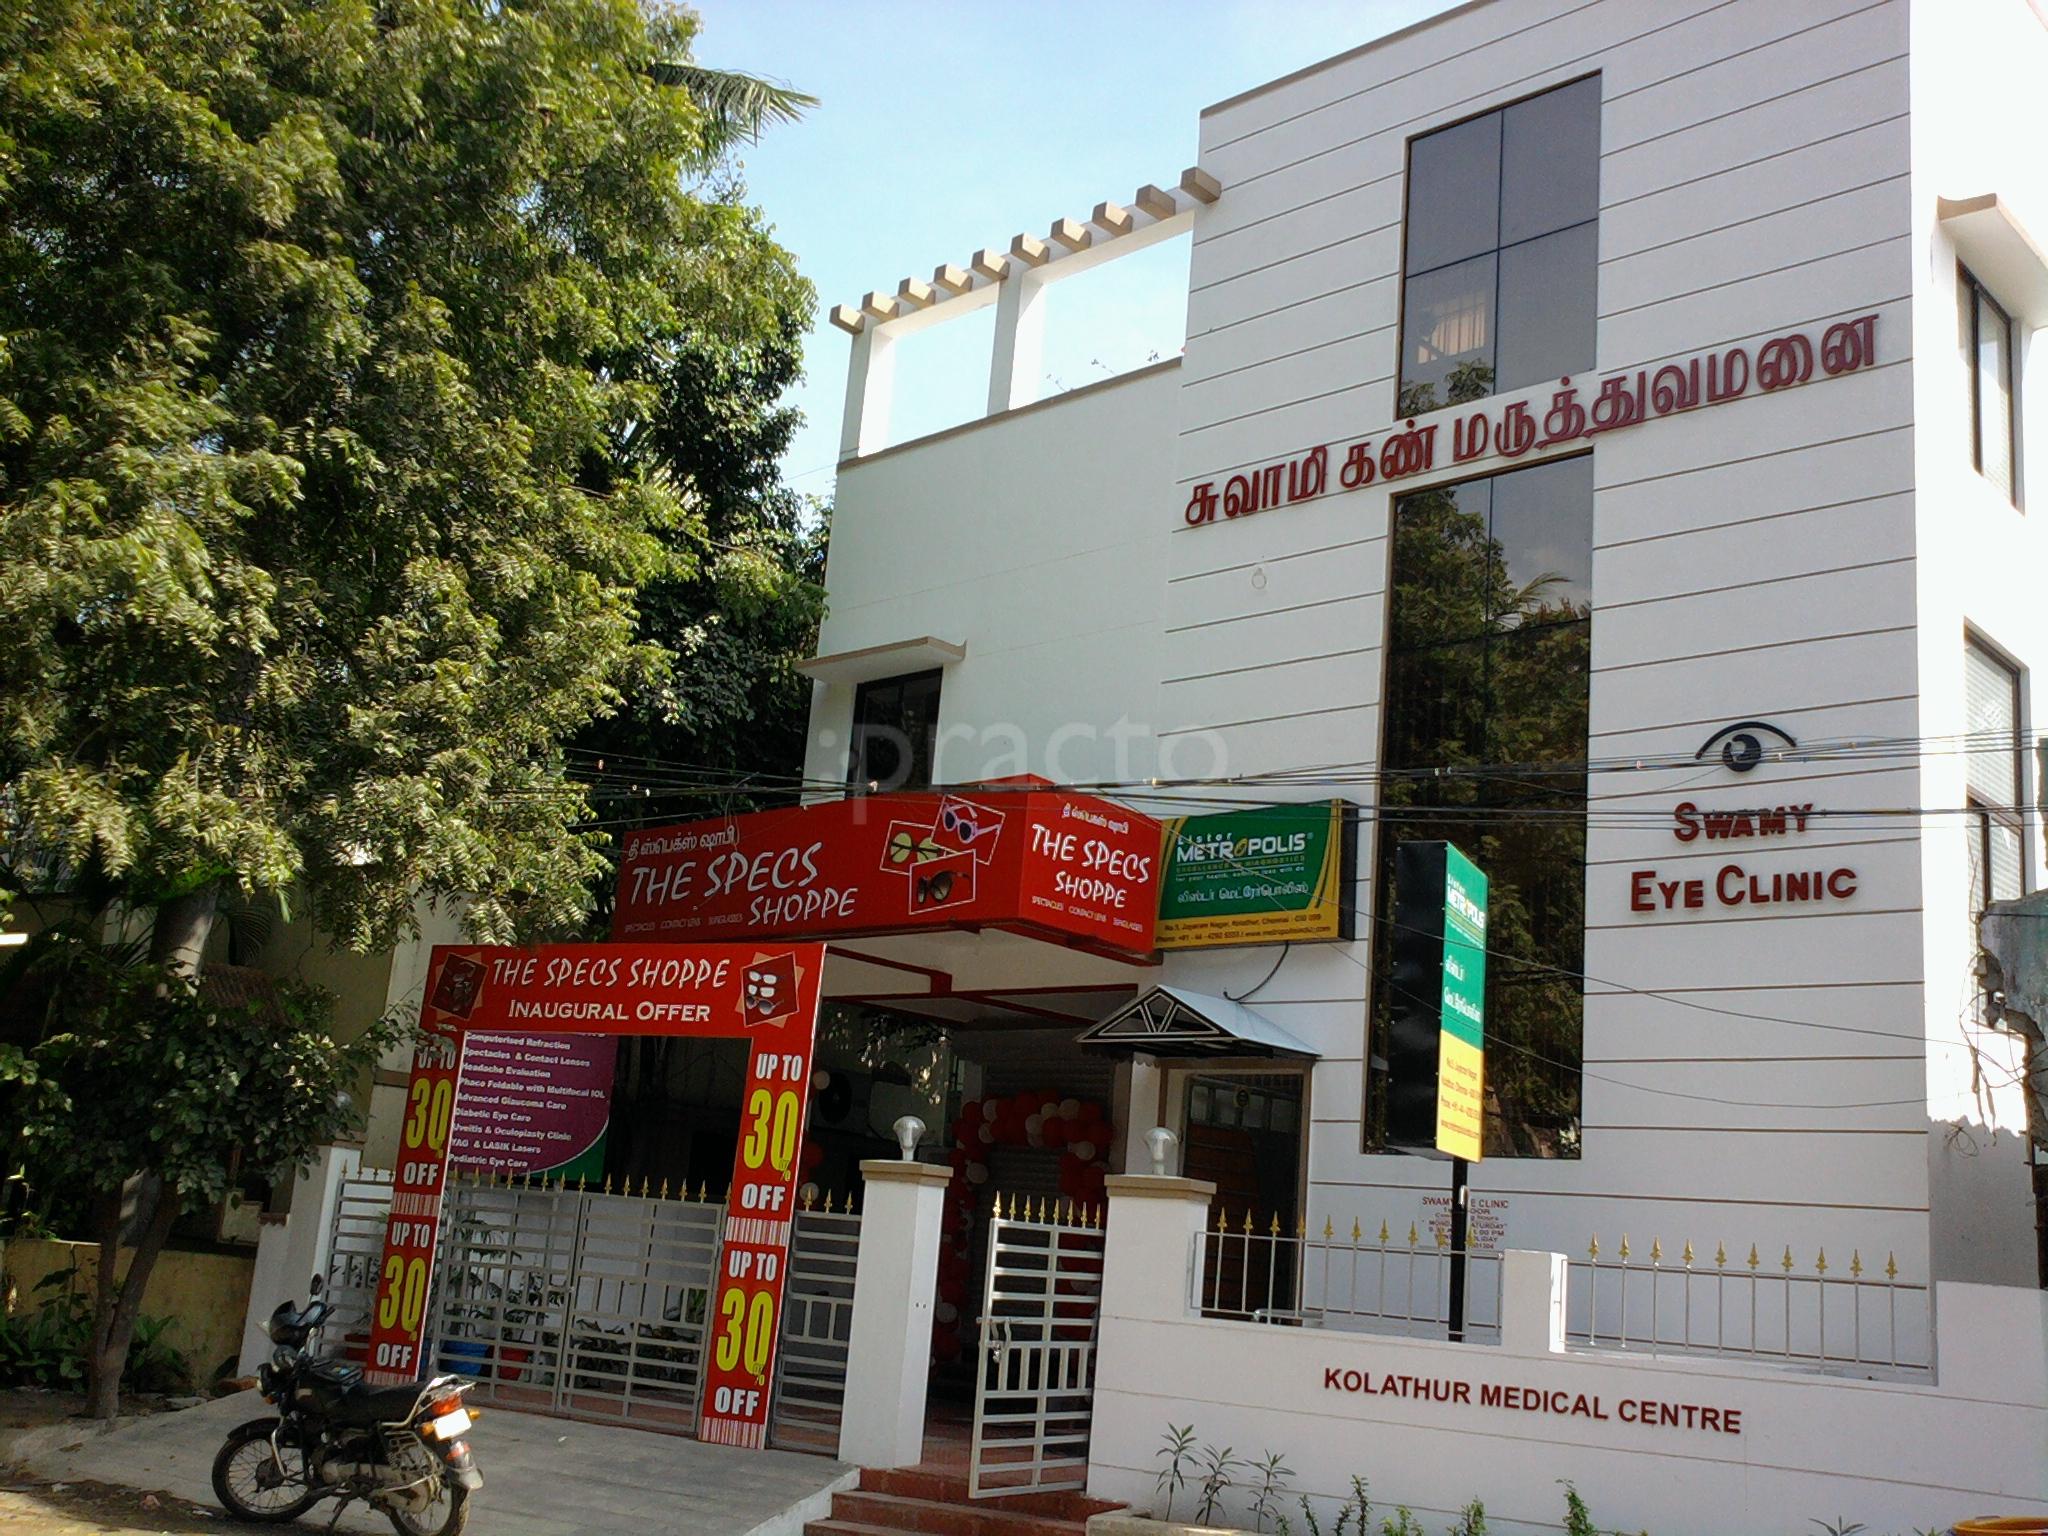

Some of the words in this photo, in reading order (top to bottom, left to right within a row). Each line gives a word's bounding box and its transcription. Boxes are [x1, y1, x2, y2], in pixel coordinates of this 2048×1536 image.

[1184, 444, 1328, 526] சுவாமி
[1340, 419, 1438, 489] கண்
[1453, 313, 1880, 462] மருத்துவமனை
[1673, 802, 1814, 842] SWAMY
[1031, 823, 1078, 861] THE
[1082, 839, 1151, 883] SPECS
[1176, 832, 1306, 863] METROPOLIS
[630, 861, 697, 906] THE
[704, 841, 823, 899] SPECS
[1054, 870, 1127, 908] SHOPPE
[1631, 870, 1704, 912] EYE
[1716, 864, 1858, 906] CLINIC
[748, 887, 859, 926] SHOPPE
[493, 957, 536, 988] THE
[543, 955, 620, 988] SPECS
[627, 957, 732, 990] SHOPPE
[507, 1000, 629, 1021] INAUGURAL
[635, 1000, 711, 1022] OFFER
[526, 1037, 571, 1050] Refraction
[505, 1065, 551, 1079] Evaluation
[524, 1053, 559, 1065] Contact
[560, 1056, 590, 1067] Lenses
[755, 1053, 779, 1081] UP
[781, 1054, 803, 1082] TO
[526, 1084, 545, 1093] with
[492, 1110, 509, 1122] Eye
[510, 1112, 532, 1123] Care
[546, 1101, 567, 1111] Care
[743, 1088, 799, 1182] 30%
[402, 1161, 439, 1187] OFF
[489, 1156, 506, 1168] Eye
[507, 1158, 528, 1168] Care
[741, 1182, 786, 1212] OFF
[391, 1221, 409, 1247] UP
[412, 1222, 430, 1249] TO
[728, 1250, 753, 1280] UP
[756, 1251, 778, 1282] TO
[716, 1287, 773, 1386] 30%
[376, 1342, 413, 1370] OFF
[714, 1385, 760, 1416] OFF
[1323, 1367, 1471, 1406] KOLATHUR
[1479, 1382, 1609, 1421] MEDICAL
[1618, 1398, 1742, 1435] CENTRE
